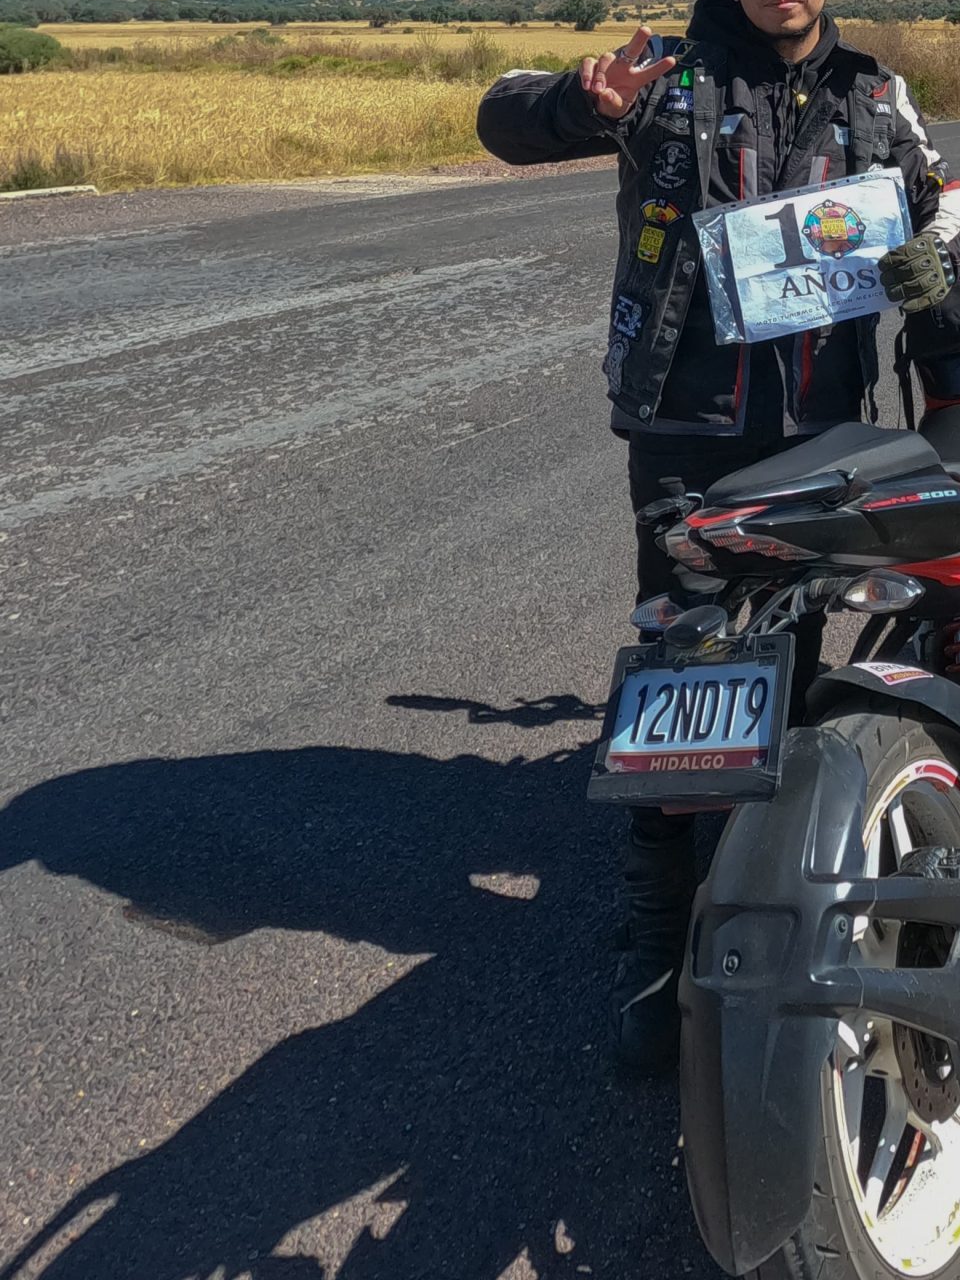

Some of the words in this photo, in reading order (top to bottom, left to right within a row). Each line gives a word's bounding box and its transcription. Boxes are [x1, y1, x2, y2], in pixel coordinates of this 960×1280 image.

[779, 266, 877, 299] AÑOS
[756, 318, 778, 327] MOTO
[780, 308, 813, 320] TURISMO
[629, 676, 769, 745] 12NDT9
[650, 754, 725, 771] HIDALGO
